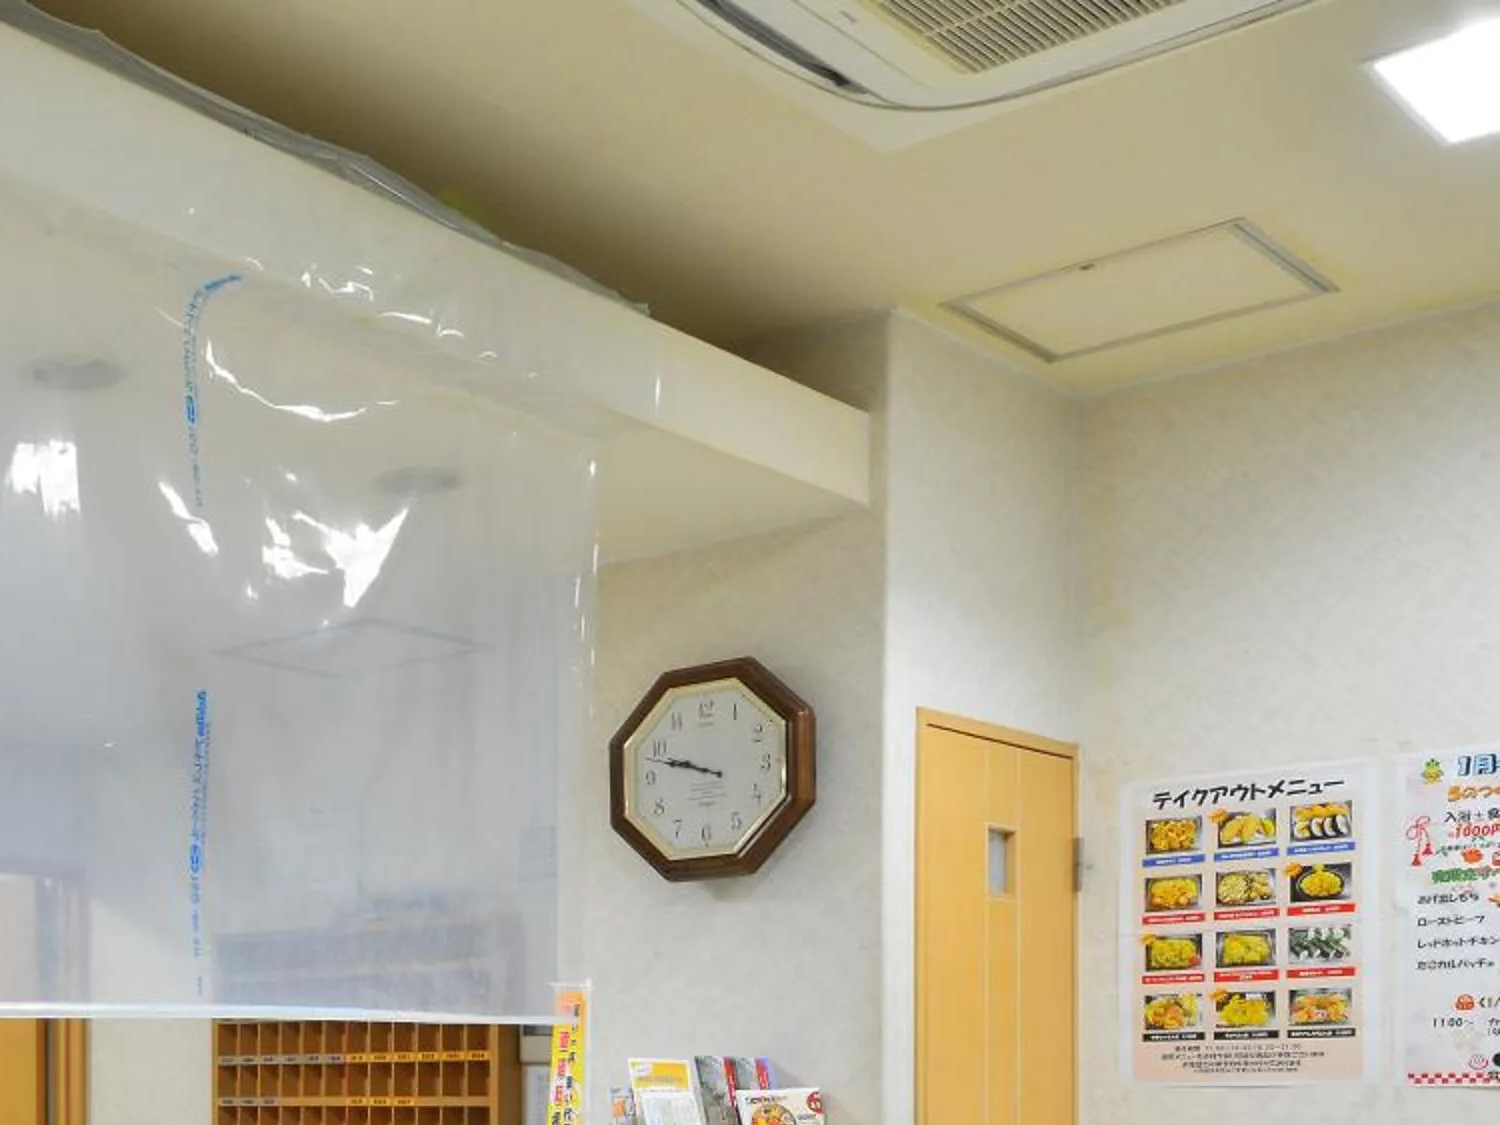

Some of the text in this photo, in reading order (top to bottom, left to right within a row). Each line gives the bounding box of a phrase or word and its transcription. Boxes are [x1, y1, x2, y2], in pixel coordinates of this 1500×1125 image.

[1458, 754, 1500, 776] 1月
[1152, 779, 1345, 810] テイクアウトメニュー
